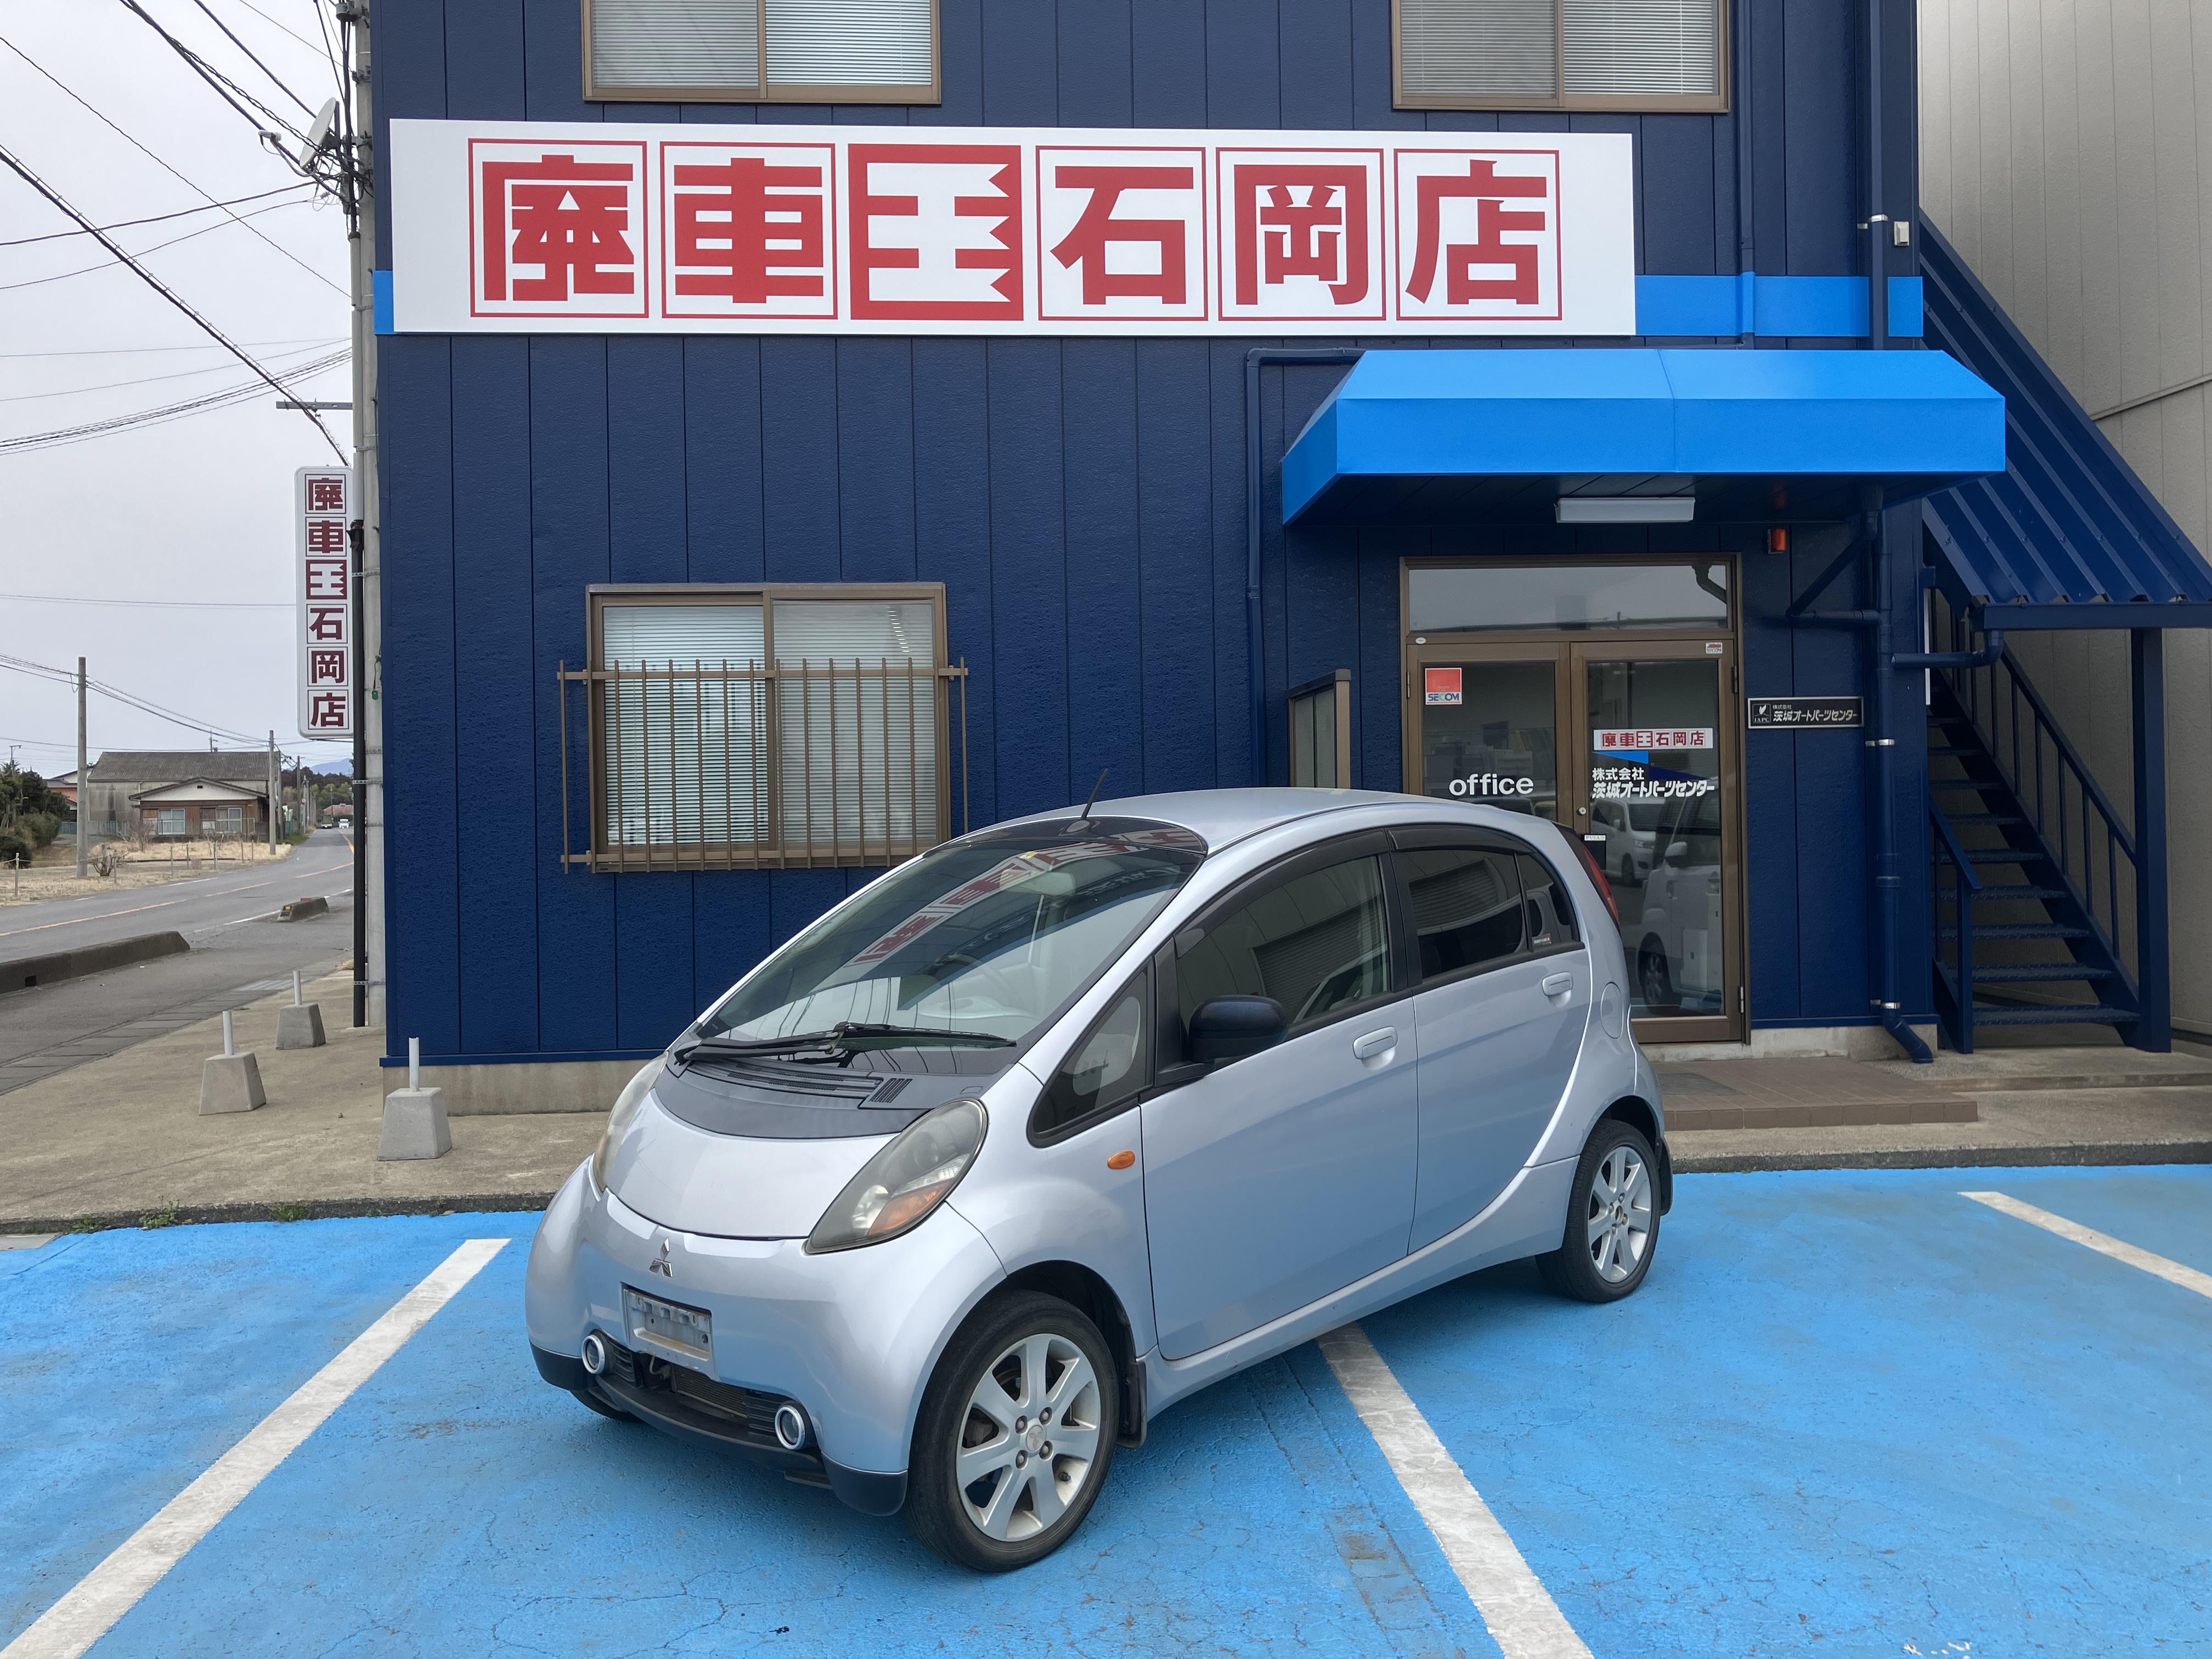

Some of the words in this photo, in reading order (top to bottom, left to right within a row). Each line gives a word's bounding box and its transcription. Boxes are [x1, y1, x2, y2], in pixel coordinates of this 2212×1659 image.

[482, 144, 1547, 320] 廃車王石岡店
[306, 477, 347, 728] 廃車王石岡店
[1428, 693, 1459, 701] SECOM
[1773, 710, 1858, 722] 茨城オートパーツセンター
[1592, 767, 1645, 781] 株式会社
[1449, 774, 1534, 796] office
[1592, 781, 1715, 799] 茨城オートパーツセンター
